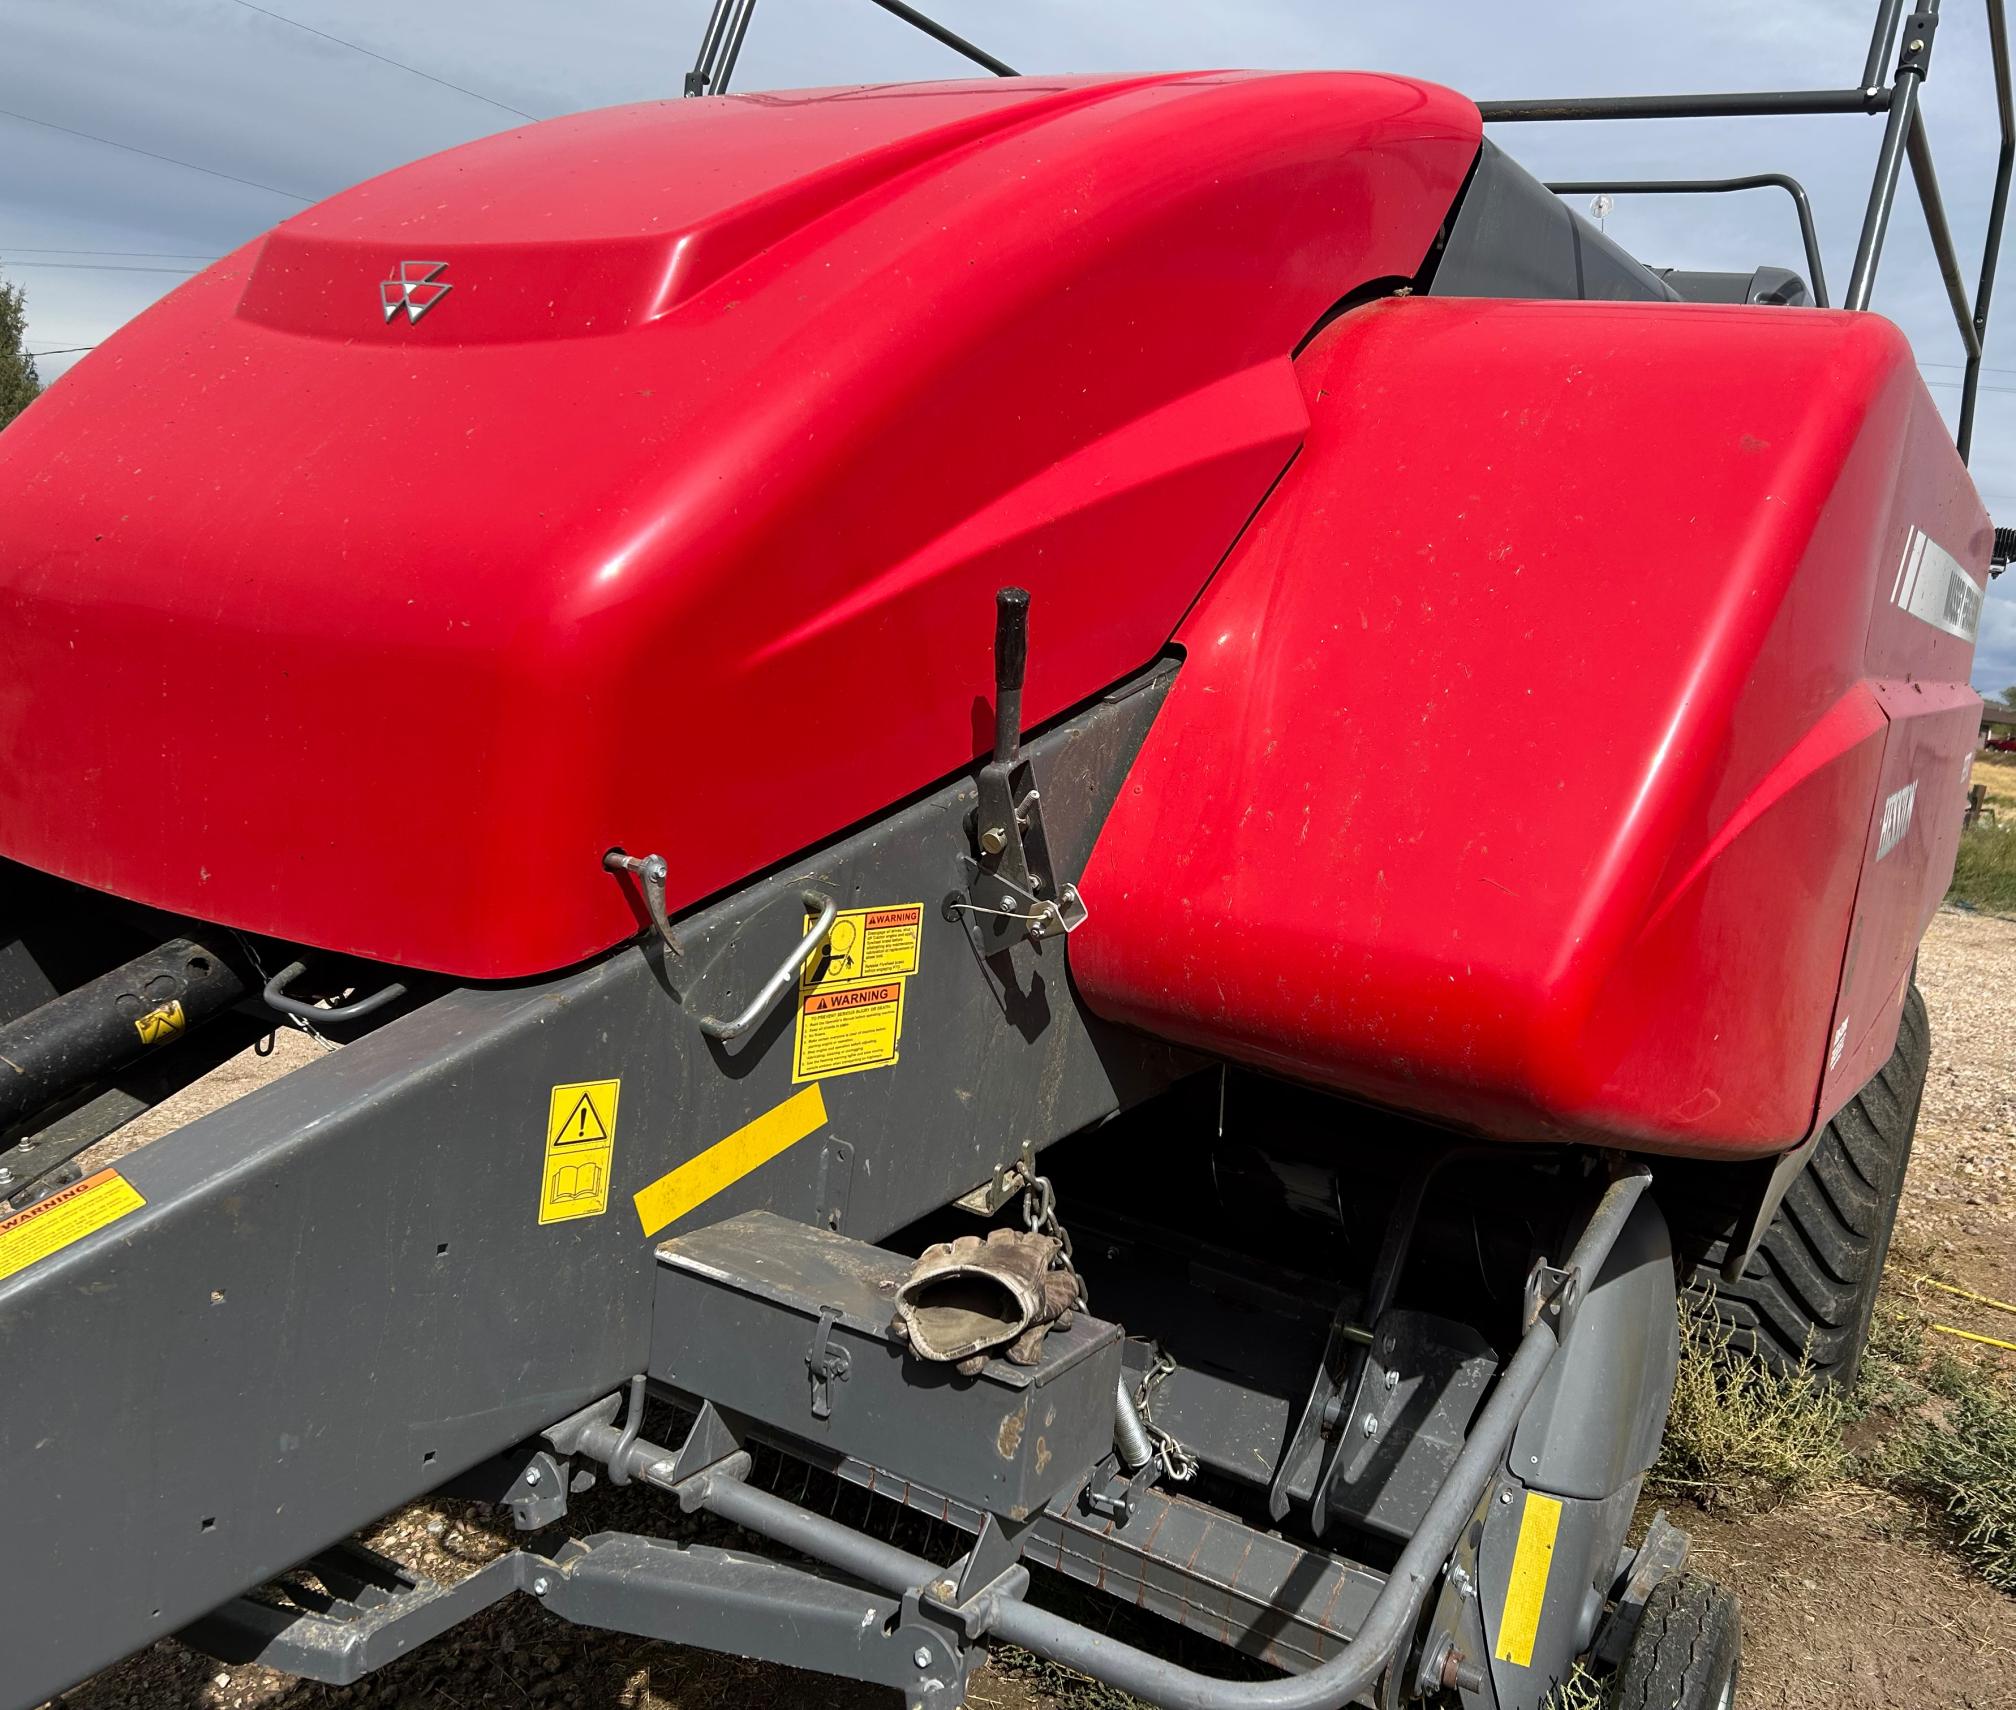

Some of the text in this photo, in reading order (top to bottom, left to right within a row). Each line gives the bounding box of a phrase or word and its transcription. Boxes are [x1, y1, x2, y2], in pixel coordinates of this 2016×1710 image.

[877, 912, 917, 923] WARNING
[831, 989, 888, 1007] WARNING
[1, 1184, 89, 1230] WARNING
